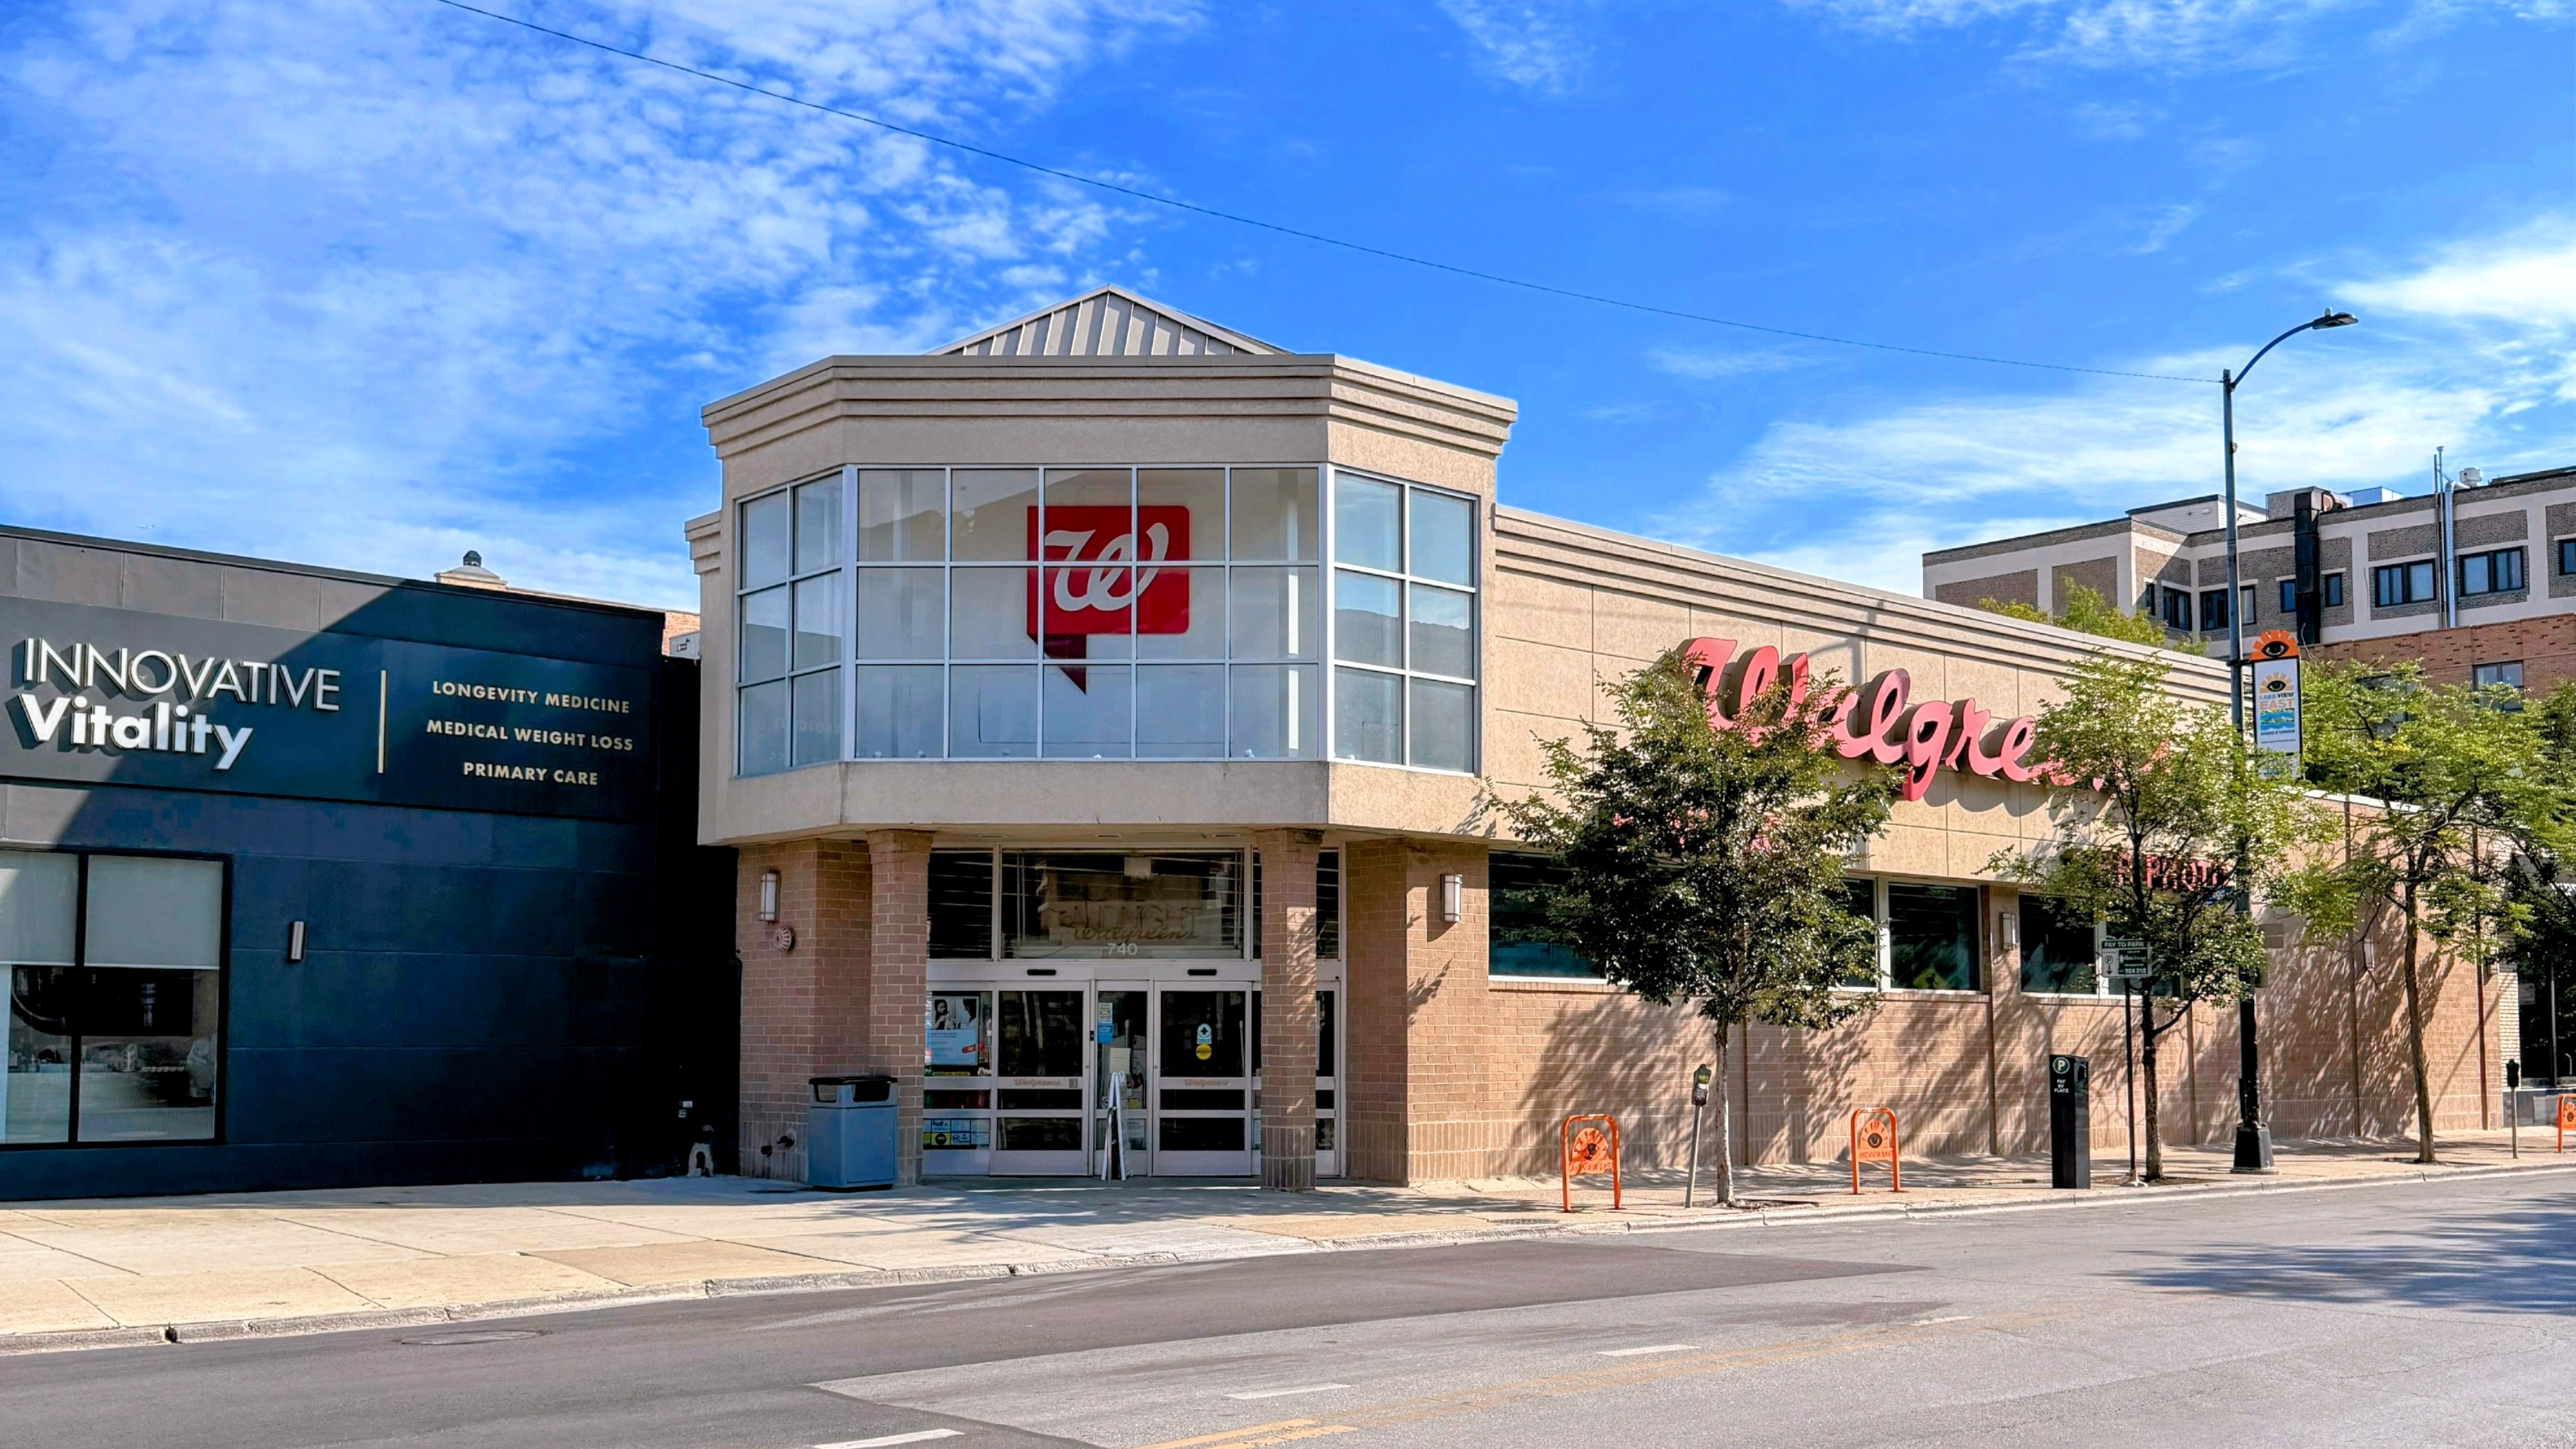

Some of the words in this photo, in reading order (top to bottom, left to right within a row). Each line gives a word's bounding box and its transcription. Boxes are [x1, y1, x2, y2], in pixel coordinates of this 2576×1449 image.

[23, 636, 341, 712] INNOVATIVE
[433, 681, 538, 704] LONGEVITY
[544, 693, 630, 714] MEDICINE
[2260, 698, 2294, 710] EAST
[18, 692, 253, 770] Vitality
[426, 719, 509, 740] MEDICAL
[514, 727, 586, 747] WEIGHT
[591, 735, 633, 751] LOSS
[1683, 636, 2173, 802] Walgre
[463, 762, 548, 781] PRIMARY
[553, 769, 599, 786] CARE
[1107, 942, 1138, 956] 740
[2057, 1060, 2066, 1071] P
